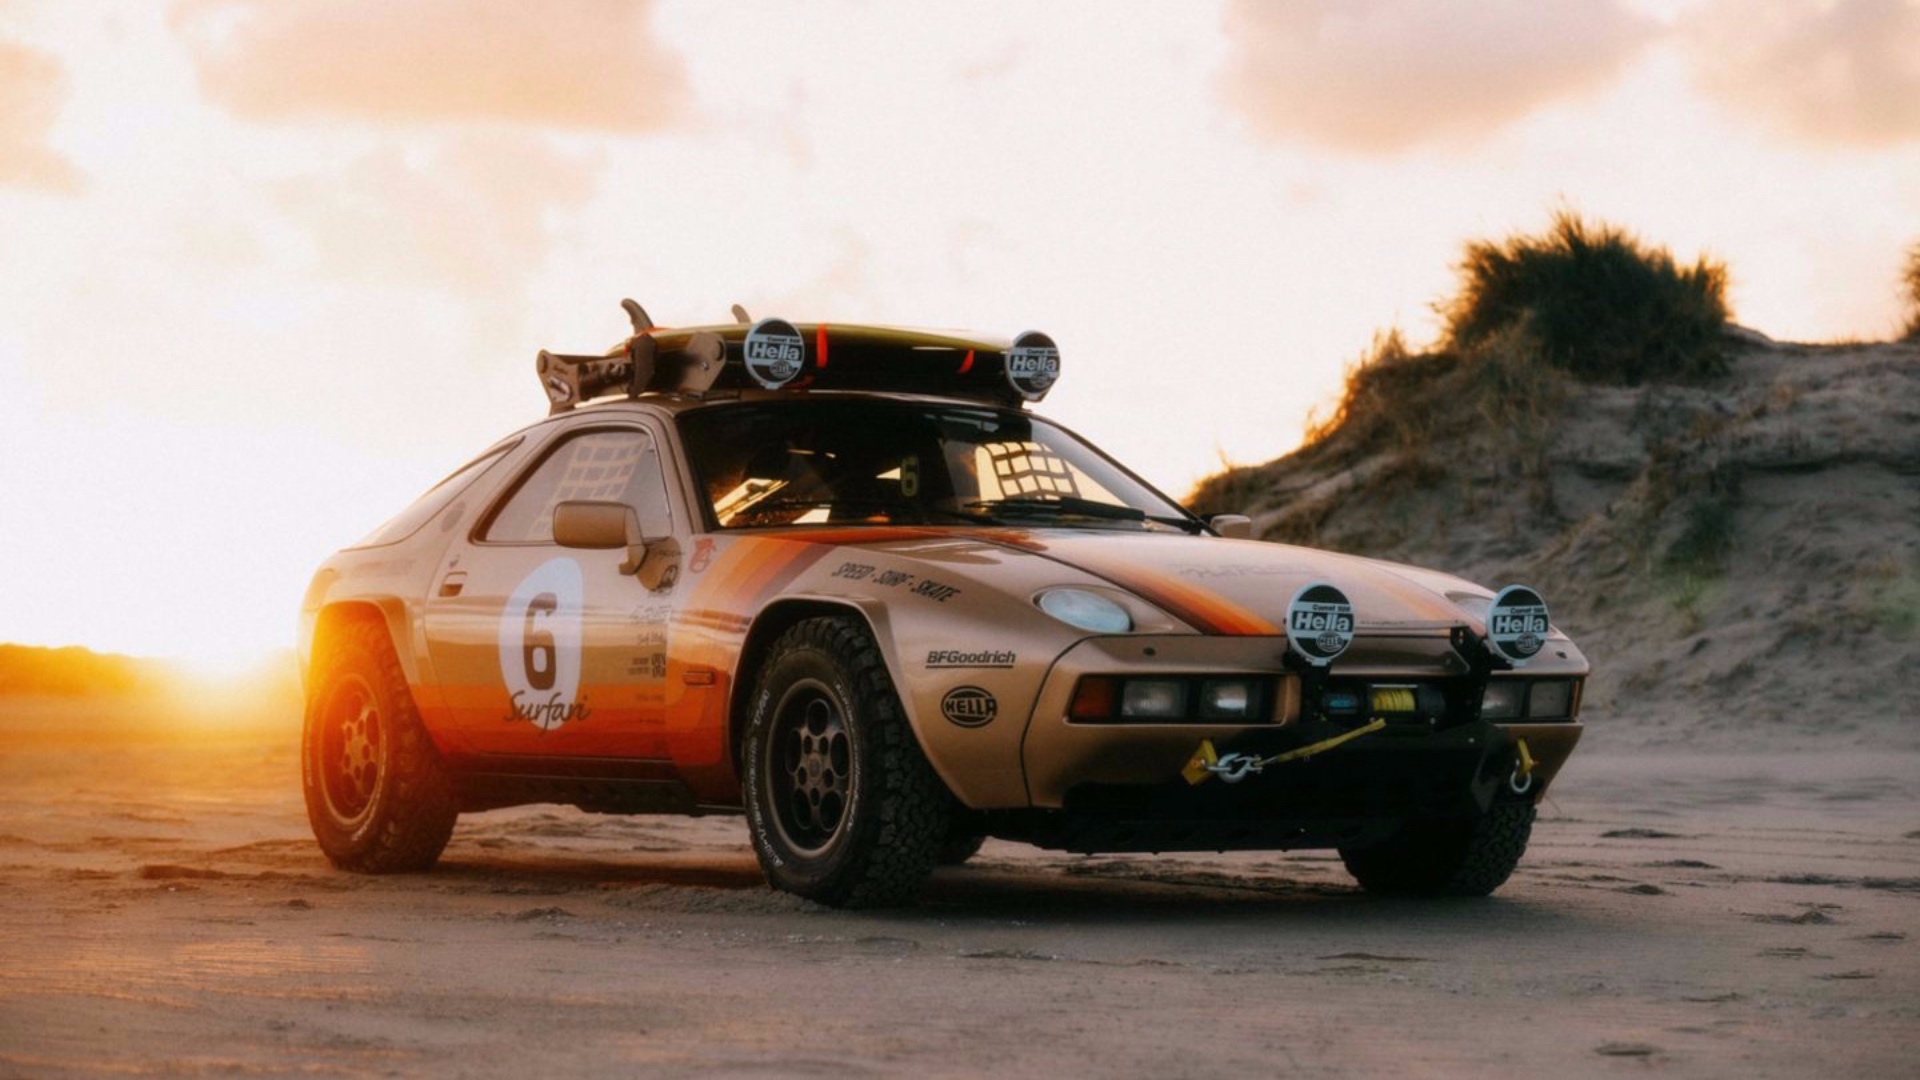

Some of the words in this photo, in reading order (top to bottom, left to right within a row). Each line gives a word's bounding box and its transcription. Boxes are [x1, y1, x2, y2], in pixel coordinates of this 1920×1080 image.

[751, 341, 800, 361] Hella
[1012, 355, 1057, 372] Hella
[901, 456, 918, 497] 6
[832, 562, 875, 580] SPEED
[872, 570, 915, 587] SURF
[910, 579, 962, 602] SKATE
[1295, 611, 1350, 632] Hella
[1495, 615, 1546, 633] Hella
[523, 592, 557, 690] 6
[926, 650, 1016, 664] BFGoodrich
[504, 690, 592, 735] Surfari
[944, 697, 998, 717] HELLA
